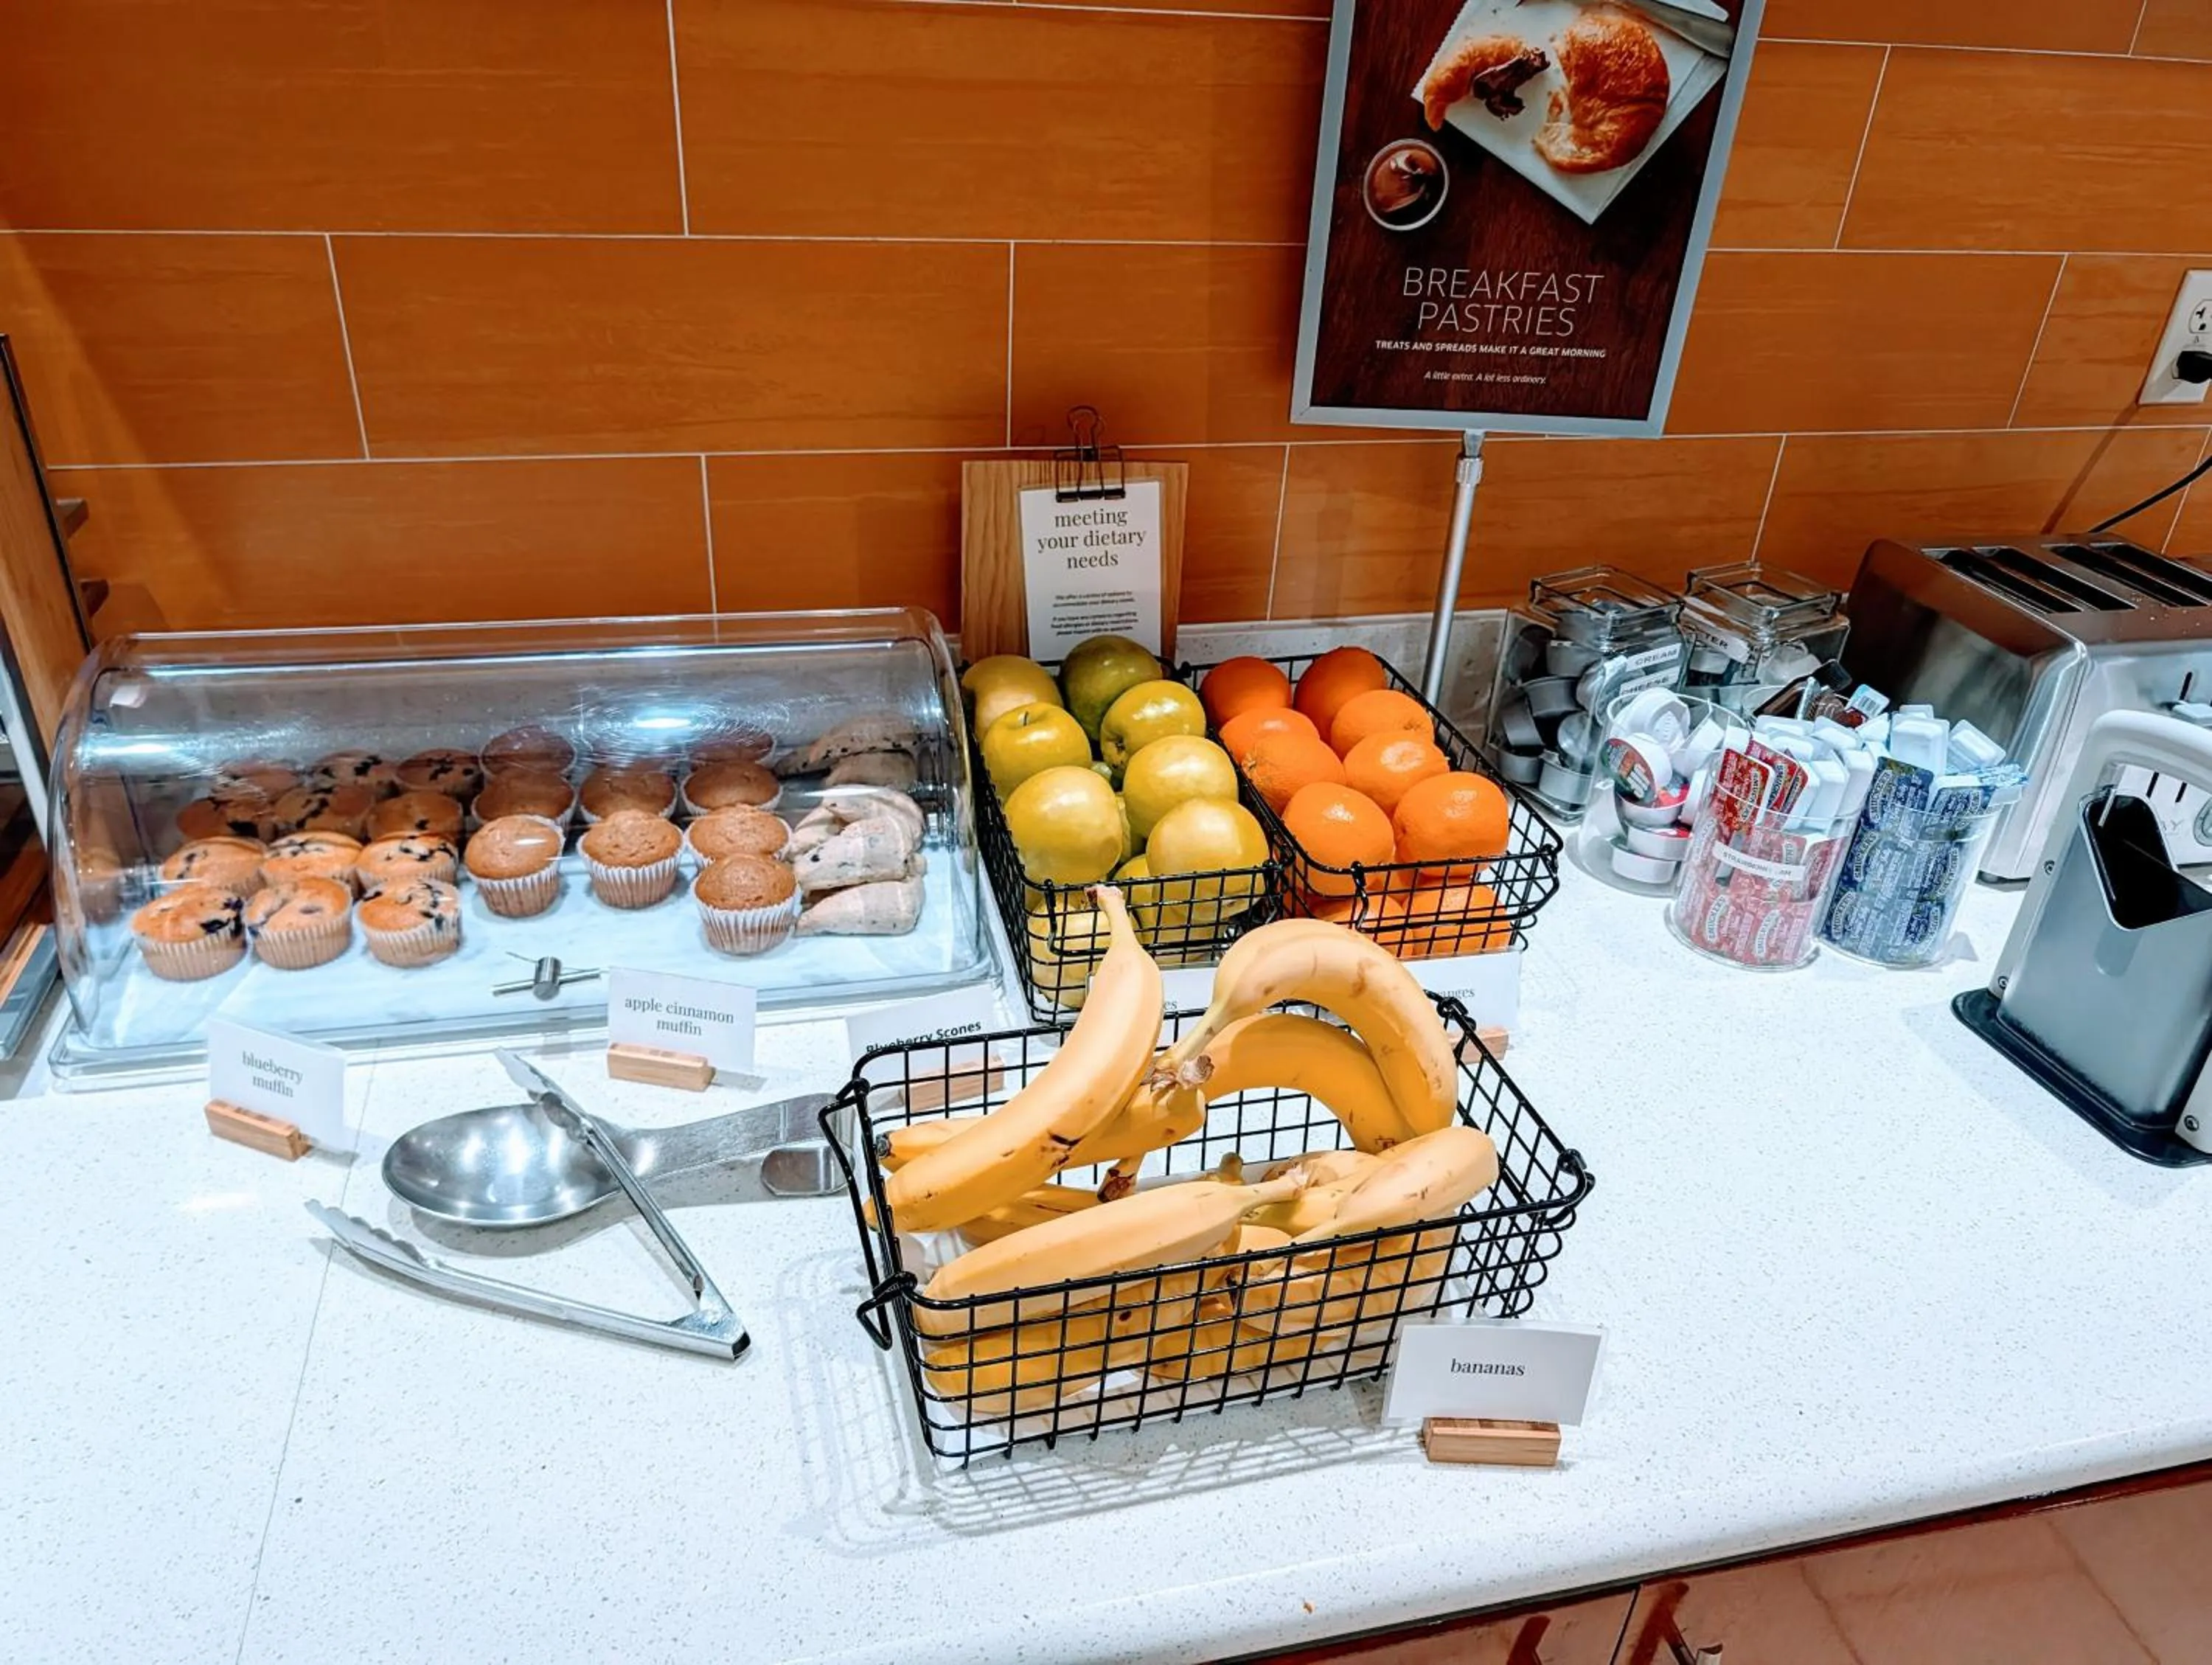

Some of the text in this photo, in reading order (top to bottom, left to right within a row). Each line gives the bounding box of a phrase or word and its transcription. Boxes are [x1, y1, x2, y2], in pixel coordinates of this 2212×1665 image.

[1403, 267, 1605, 304] BREAKFAST
[1418, 302, 1576, 337] PASTRIES
[1375, 340, 1607, 358] TREATS AND SPREADS MAKE IT A GREAT MORNING
[1424, 371, 1431, 379] A
[1475, 373, 1483, 381] A
[1054, 508, 1128, 527] meeting
[1037, 529, 1147, 553] your dietary
[1067, 550, 1119, 569] needs
[1635, 649, 1677, 665] CREAM
[625, 998, 734, 1024] apple cinnamon
[656, 1018, 702, 1036] muffin
[936, 1021, 981, 1040] Scones
[241, 1050, 304, 1085] blueberry
[252, 1075, 293, 1098] muffin
[1450, 1357, 1526, 1377] bananas
